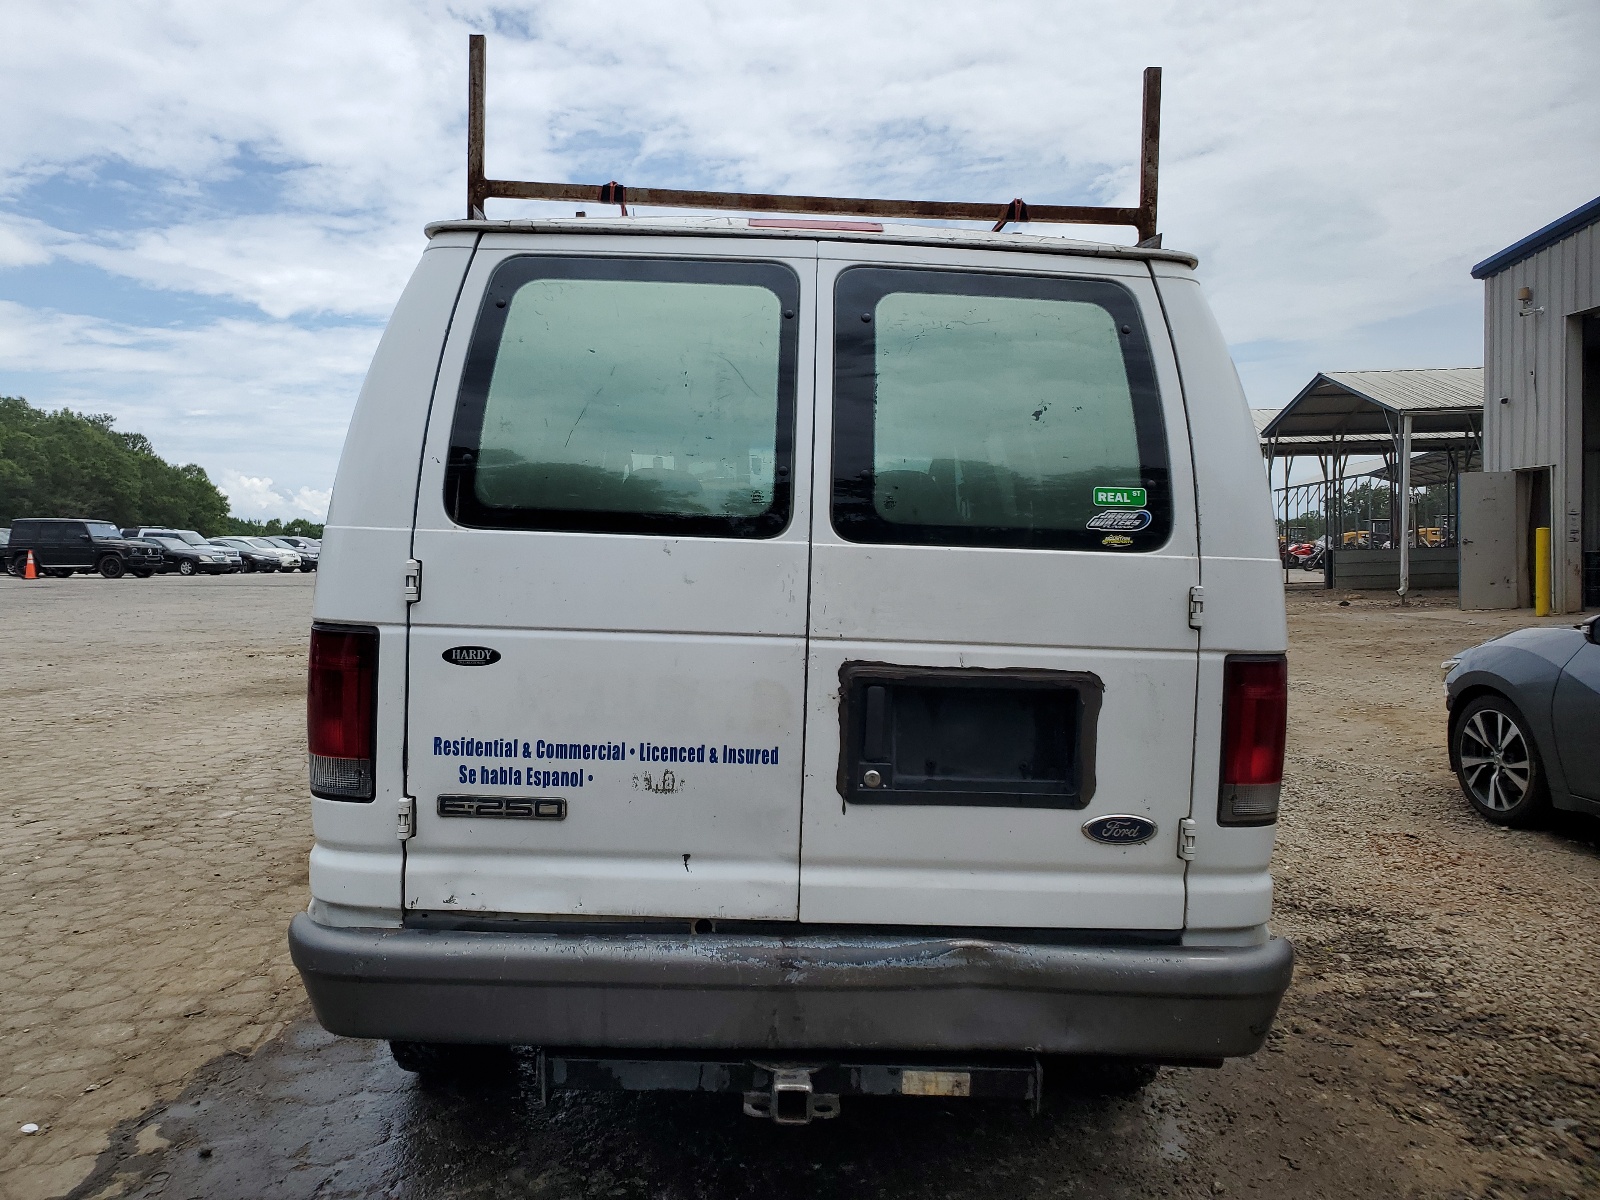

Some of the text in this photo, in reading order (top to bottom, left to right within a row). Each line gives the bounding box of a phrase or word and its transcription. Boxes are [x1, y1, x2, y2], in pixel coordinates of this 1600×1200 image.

[1097, 491, 1131, 503] REAL
[1088, 519, 1142, 527] WATERS
[1099, 512, 1139, 520] JASON
[451, 649, 493, 660] HARDY
[433, 736, 779, 765] Residential & Commercial Licenced & Insured
[458, 764, 584, 789] Se habla Espanol
[438, 796, 564, 819] E-250
[1101, 820, 1140, 837] Ford
